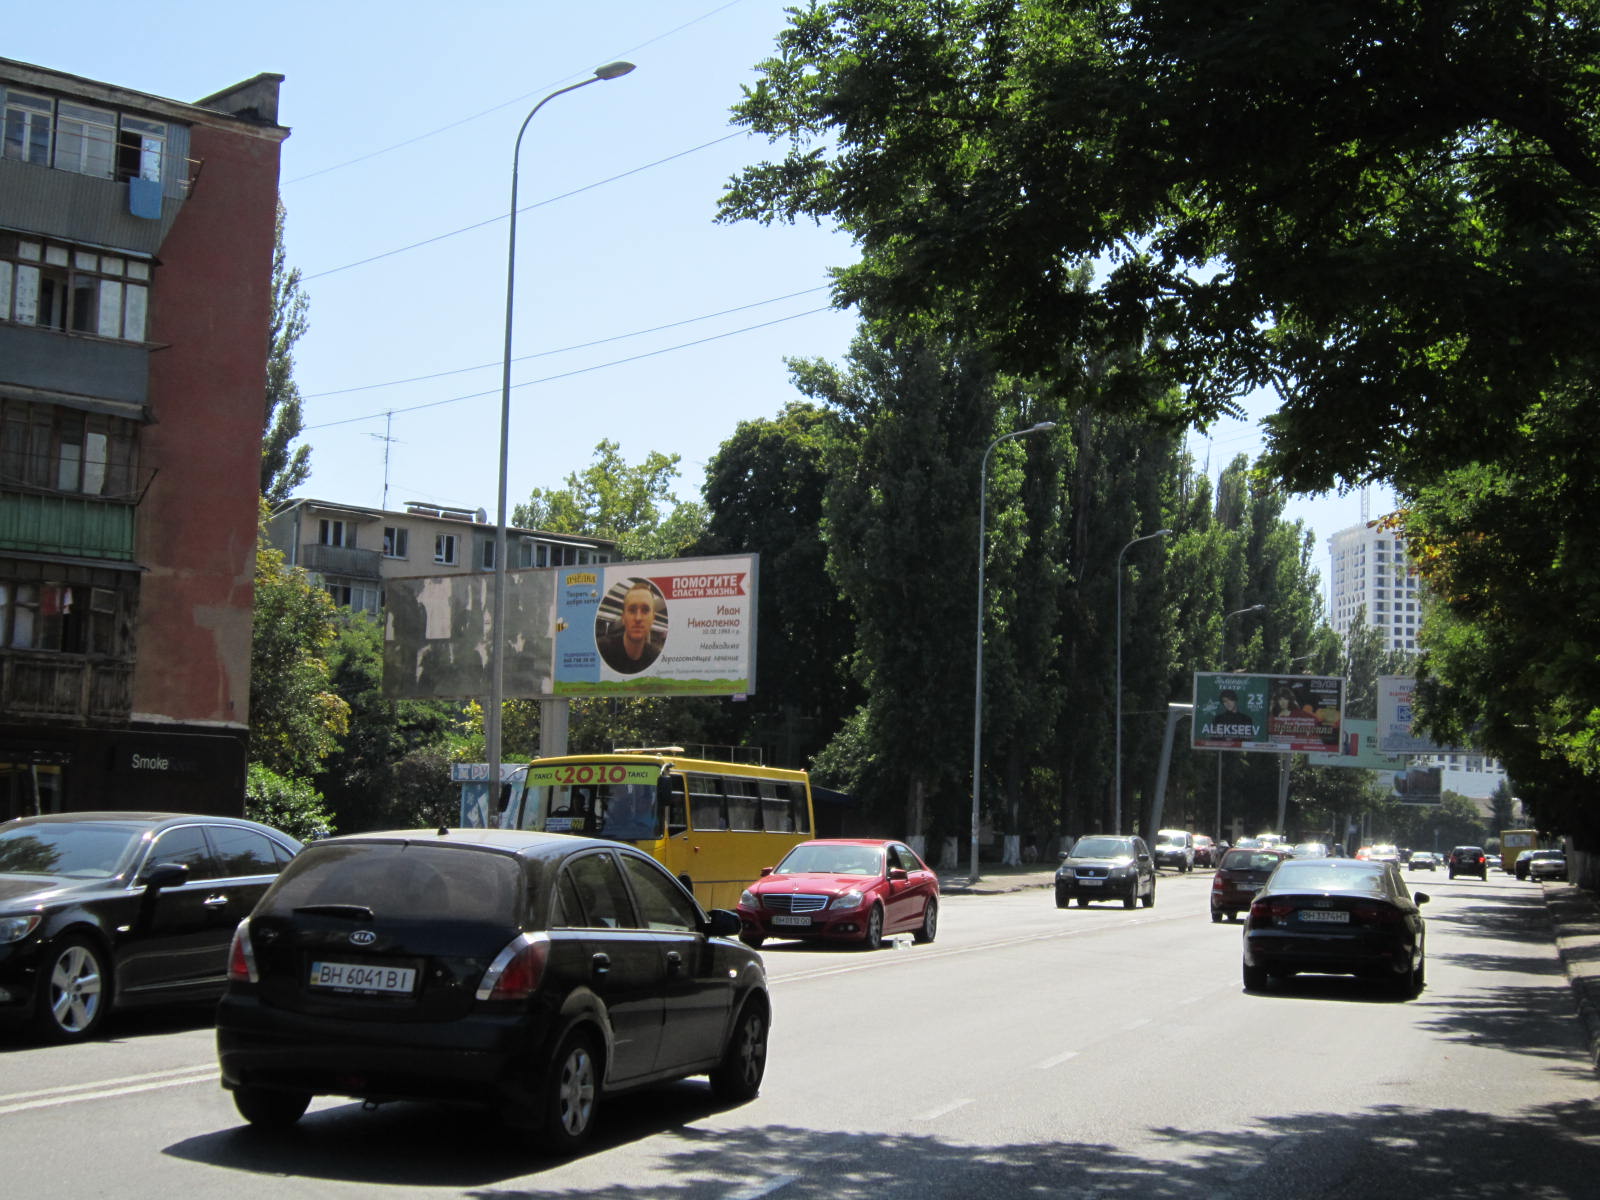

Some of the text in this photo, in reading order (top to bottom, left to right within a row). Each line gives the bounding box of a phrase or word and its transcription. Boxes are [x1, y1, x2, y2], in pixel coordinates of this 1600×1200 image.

[672, 575, 737, 589] ПОМОГИТЕ
[672, 586, 737, 598] СПАСТИ ЖИЗНЬ!
[717, 605, 740, 615] Иван
[687, 617, 740, 628] Николенко
[1248, 694, 1264, 705] 23
[1202, 723, 1260, 736] ALEKSEEV
[131, 753, 168, 770] Smoke
[353, 932, 372, 942] KIA
[346, 967, 382, 987] 6041
